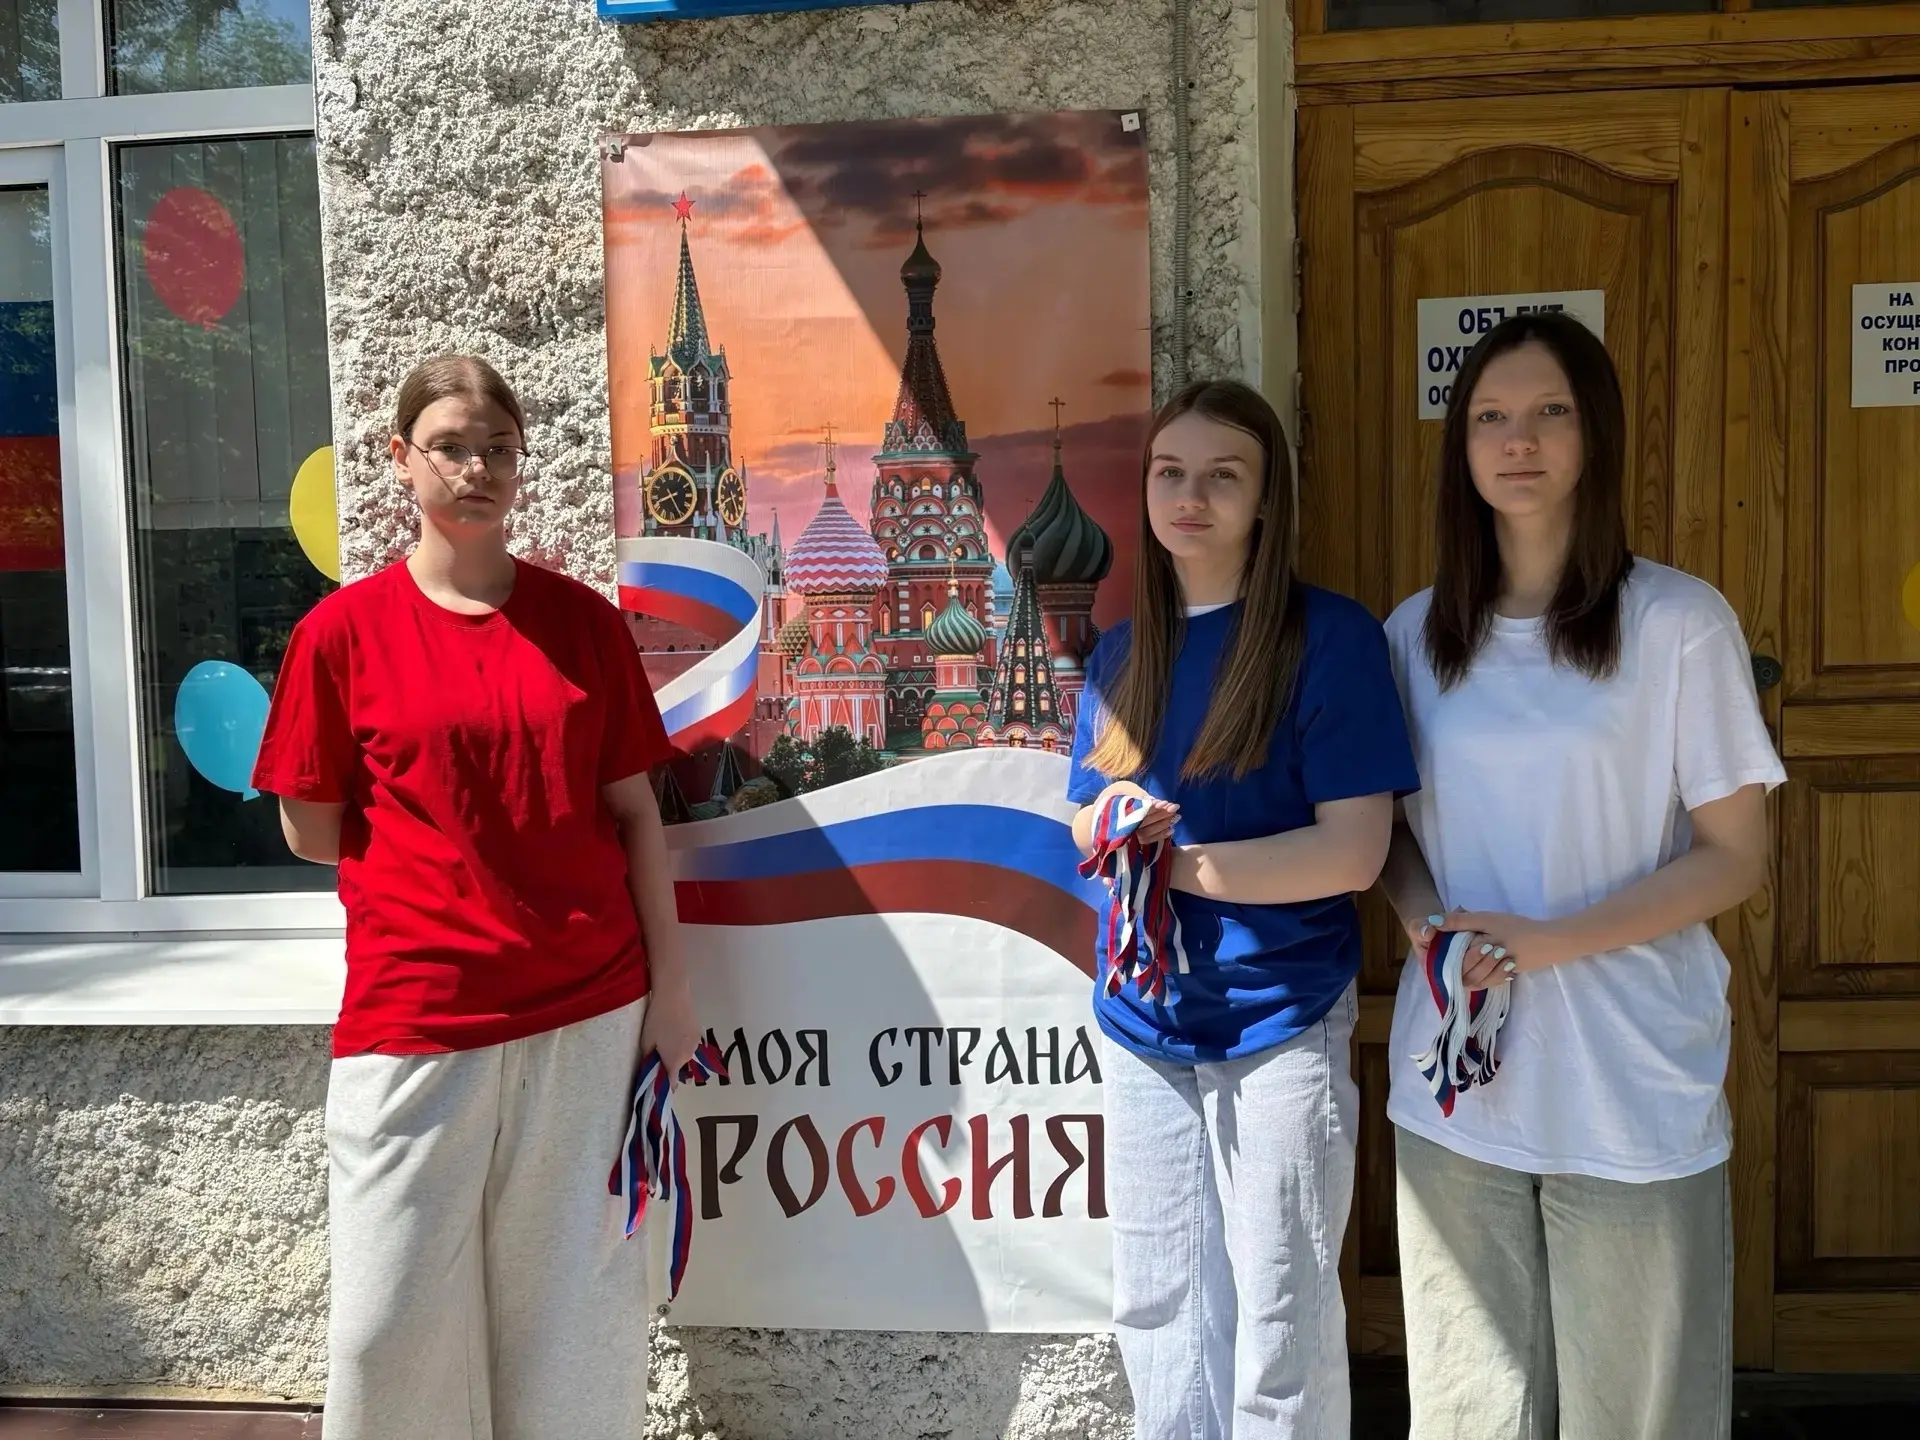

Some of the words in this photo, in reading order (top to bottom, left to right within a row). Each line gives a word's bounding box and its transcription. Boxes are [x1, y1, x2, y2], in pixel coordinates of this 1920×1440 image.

[1889, 292, 1914, 307] НА
[694, 1027, 831, 1087] МОЯ
[869, 1025, 1104, 1087] СТРАНА
[695, 1114, 1109, 1221] РОССИЯ
